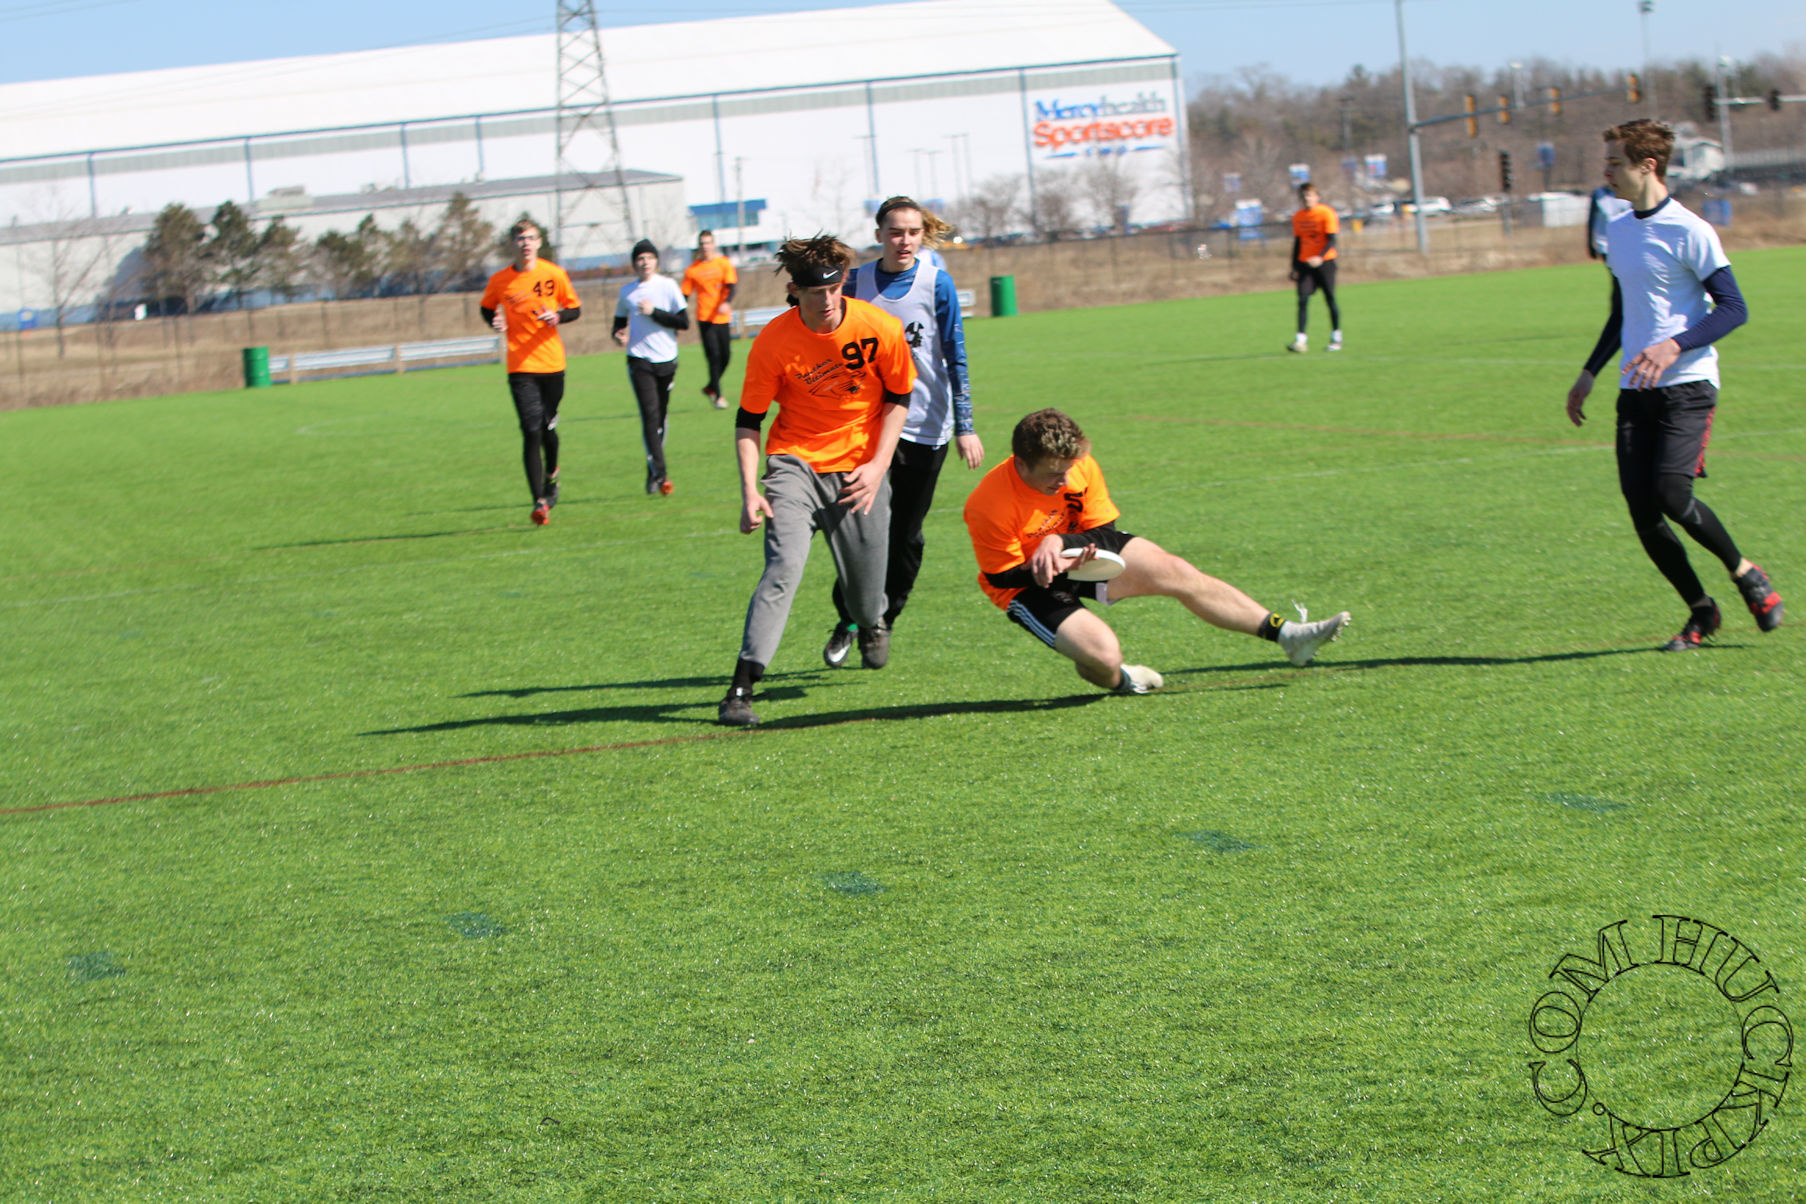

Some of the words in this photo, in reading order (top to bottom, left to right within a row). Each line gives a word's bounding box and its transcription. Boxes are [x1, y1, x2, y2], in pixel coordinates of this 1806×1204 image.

[1035, 91, 1168, 121] Mercyhealth
[1033, 117, 1174, 150] Sportscore
[841, 337, 879, 370] 97
